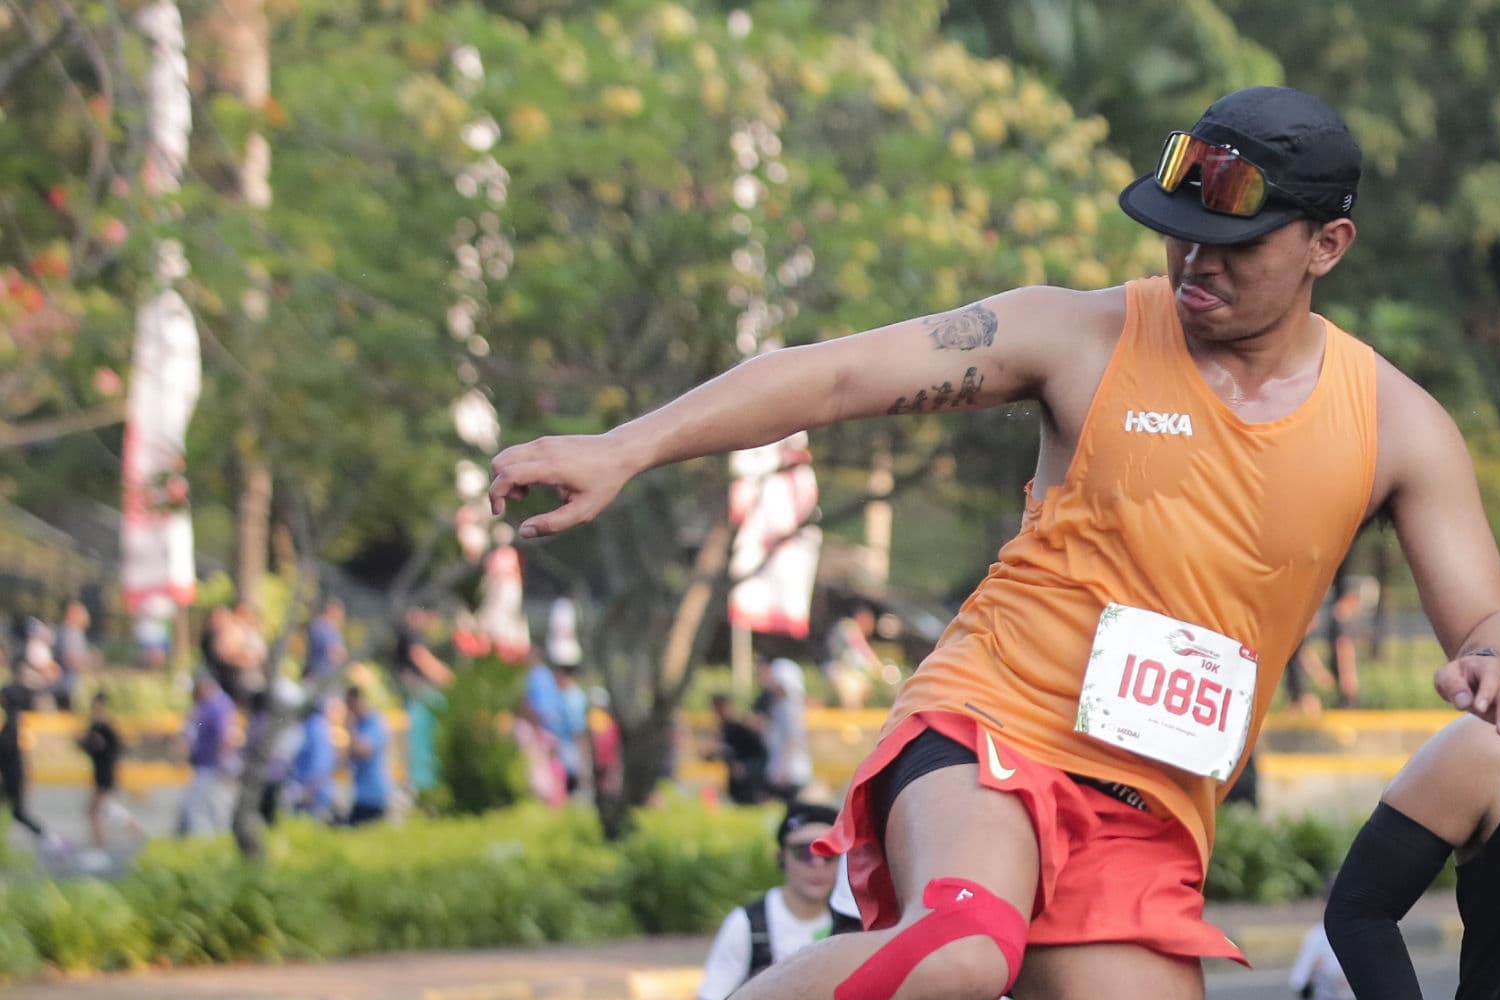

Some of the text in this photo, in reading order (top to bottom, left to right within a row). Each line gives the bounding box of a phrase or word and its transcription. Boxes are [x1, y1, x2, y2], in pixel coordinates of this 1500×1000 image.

[1124, 410, 1194, 437] HOKA
[1200, 659, 1222, 675] 10K
[1117, 653, 1233, 733] 10851
